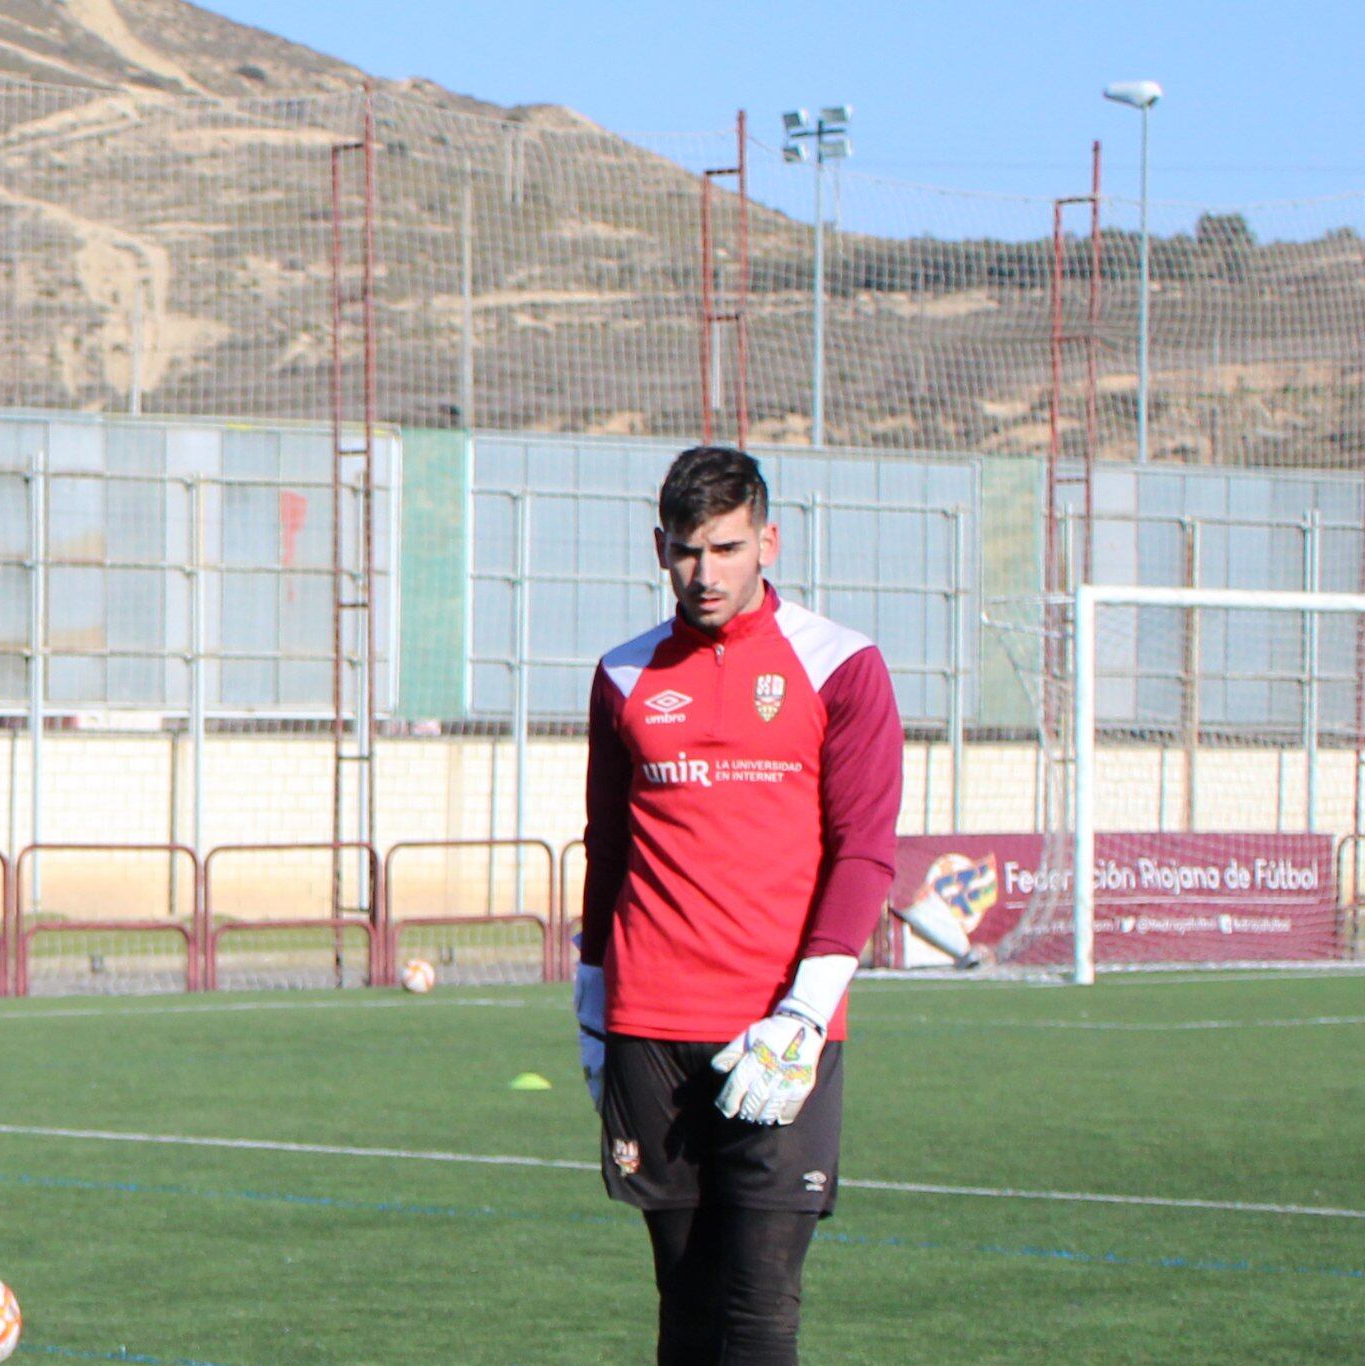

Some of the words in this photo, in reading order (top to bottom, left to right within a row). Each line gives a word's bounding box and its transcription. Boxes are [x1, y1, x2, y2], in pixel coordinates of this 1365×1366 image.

[645, 712, 686, 725] umbro
[715, 759, 729, 770] LA
[731, 760, 803, 773] UNIVERSIDAD
[715, 771, 730, 782] EN
[733, 771, 784, 782] INTERNET
[1004, 859, 1136, 894] Federción
[1223, 857, 1251, 889] de
[1254, 857, 1318, 890] Fútbol
